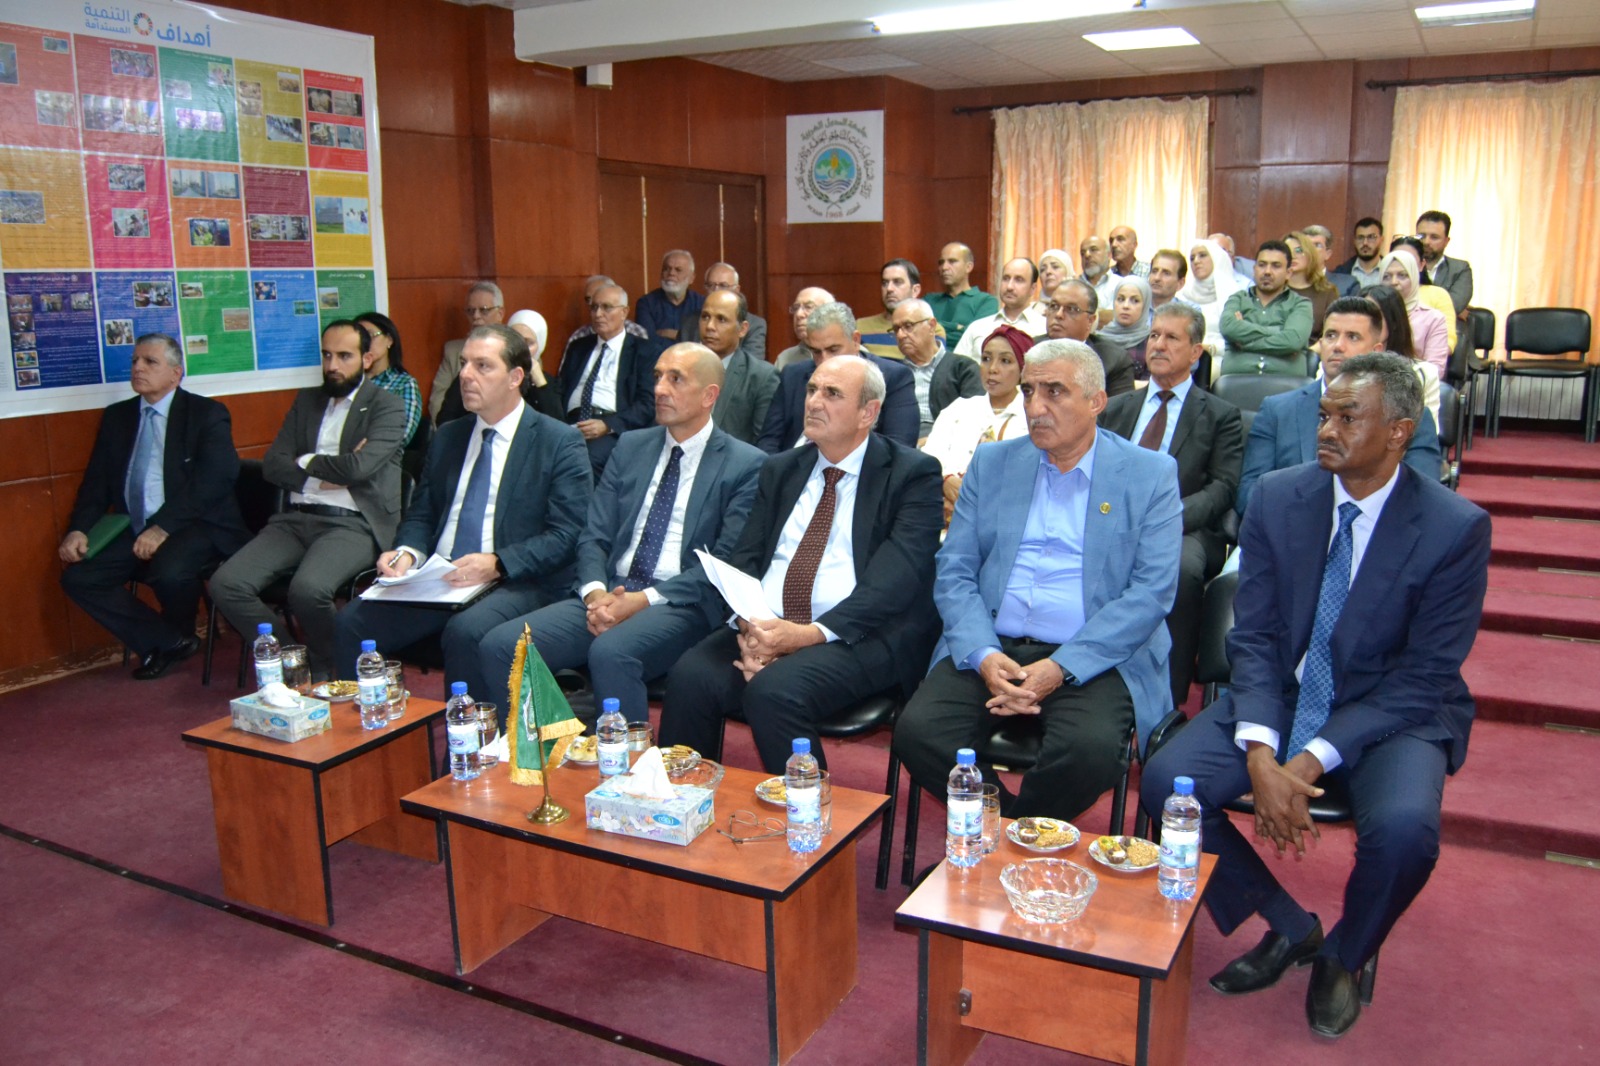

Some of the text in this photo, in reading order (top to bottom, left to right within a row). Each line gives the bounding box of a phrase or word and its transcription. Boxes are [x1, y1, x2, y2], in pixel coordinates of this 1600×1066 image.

[83, 2, 130, 22] التنمية
[85, 20, 131, 34] المستدامة
[156, 24, 211, 47] أهداف
